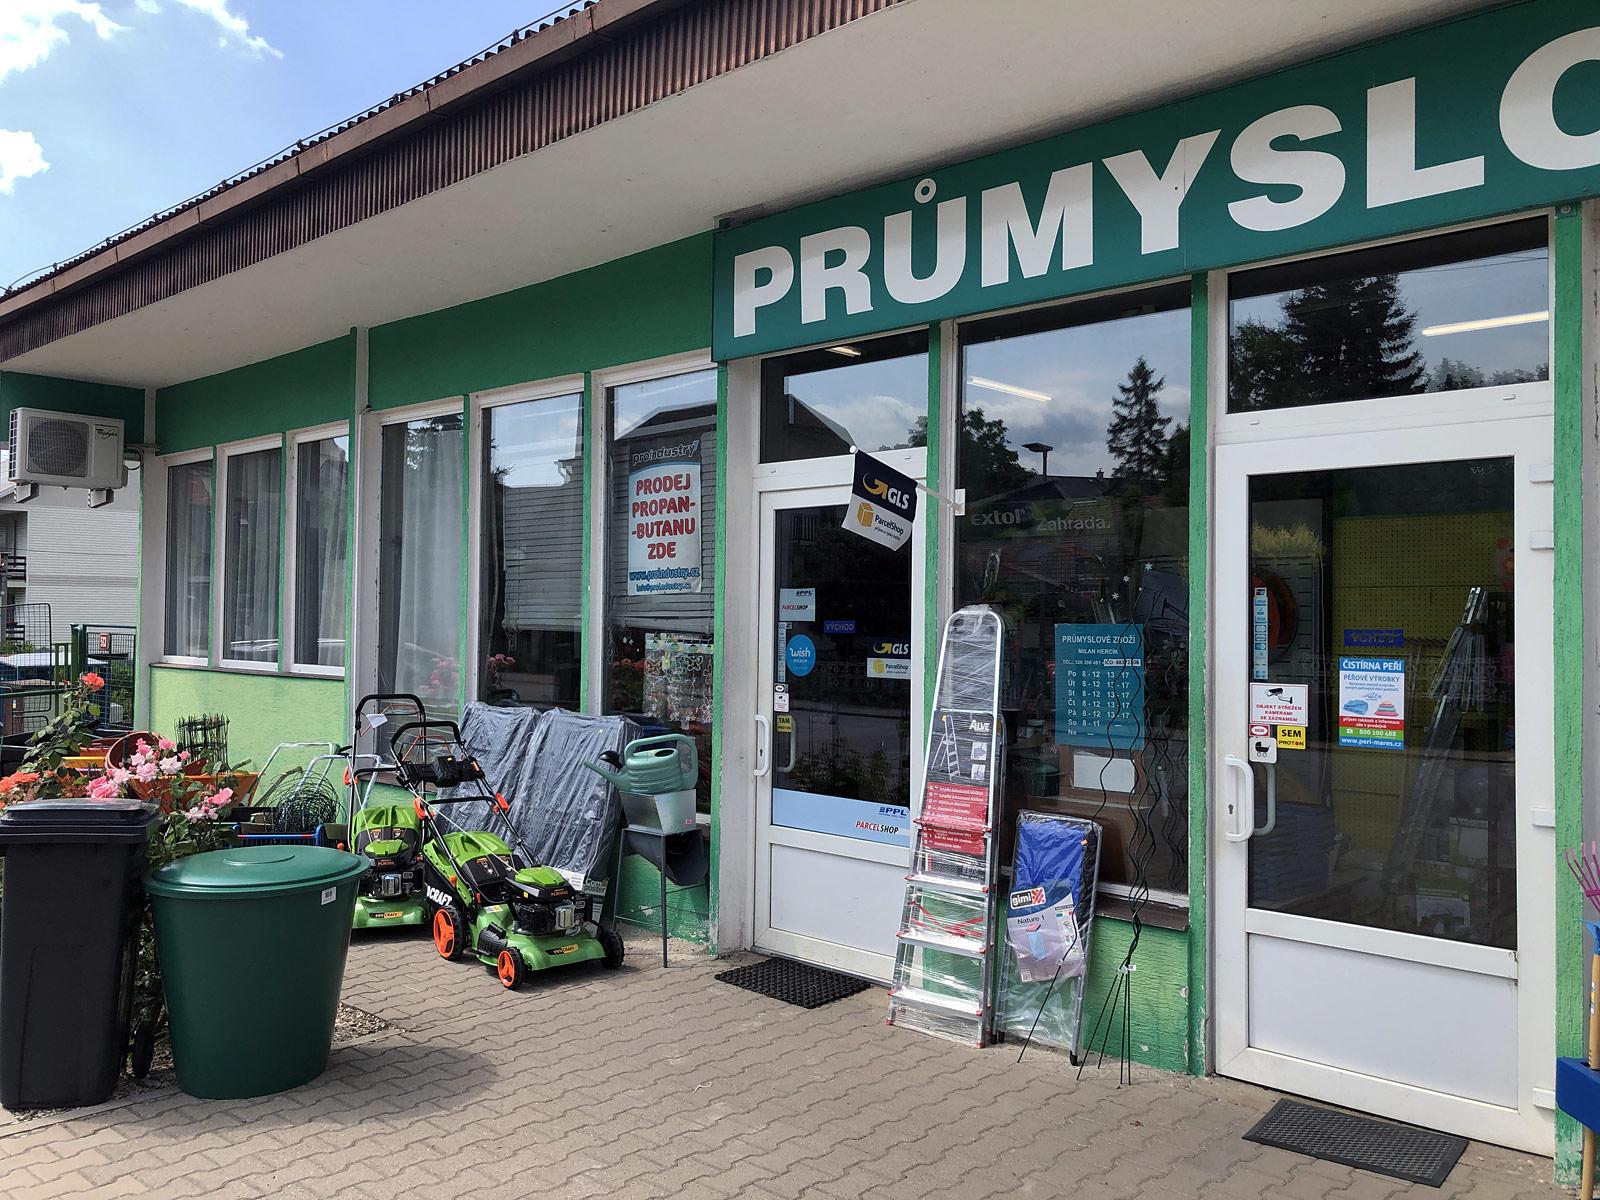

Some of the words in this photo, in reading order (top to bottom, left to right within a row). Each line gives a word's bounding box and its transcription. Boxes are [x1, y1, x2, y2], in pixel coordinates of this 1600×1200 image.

[633, 441, 698, 466] proindustry
[636, 473, 691, 496] PRODEJ
[888, 488, 909, 509] GLS
[632, 496, 696, 518] PROPAN-
[632, 517, 696, 539] -BUTANU
[875, 515, 904, 536] ParcelShop
[648, 541, 677, 560] ZDE
[629, 566, 700, 582] www.proindustry.cz
[1062, 633, 1111, 644] PRŮMYSLOVÉ
[790, 647, 810, 657] wish
[892, 643, 909, 655] GLS
[1342, 659, 1381, 669] ČISTÍRNA
[1383, 660, 1402, 670] PEŘÍ
[1281, 729, 1302, 737] SEM
[1341, 738, 1402, 747] www.peri-mares.cz
[886, 807, 907, 816] PPL
[856, 821, 899, 834] PARCELSHOP
